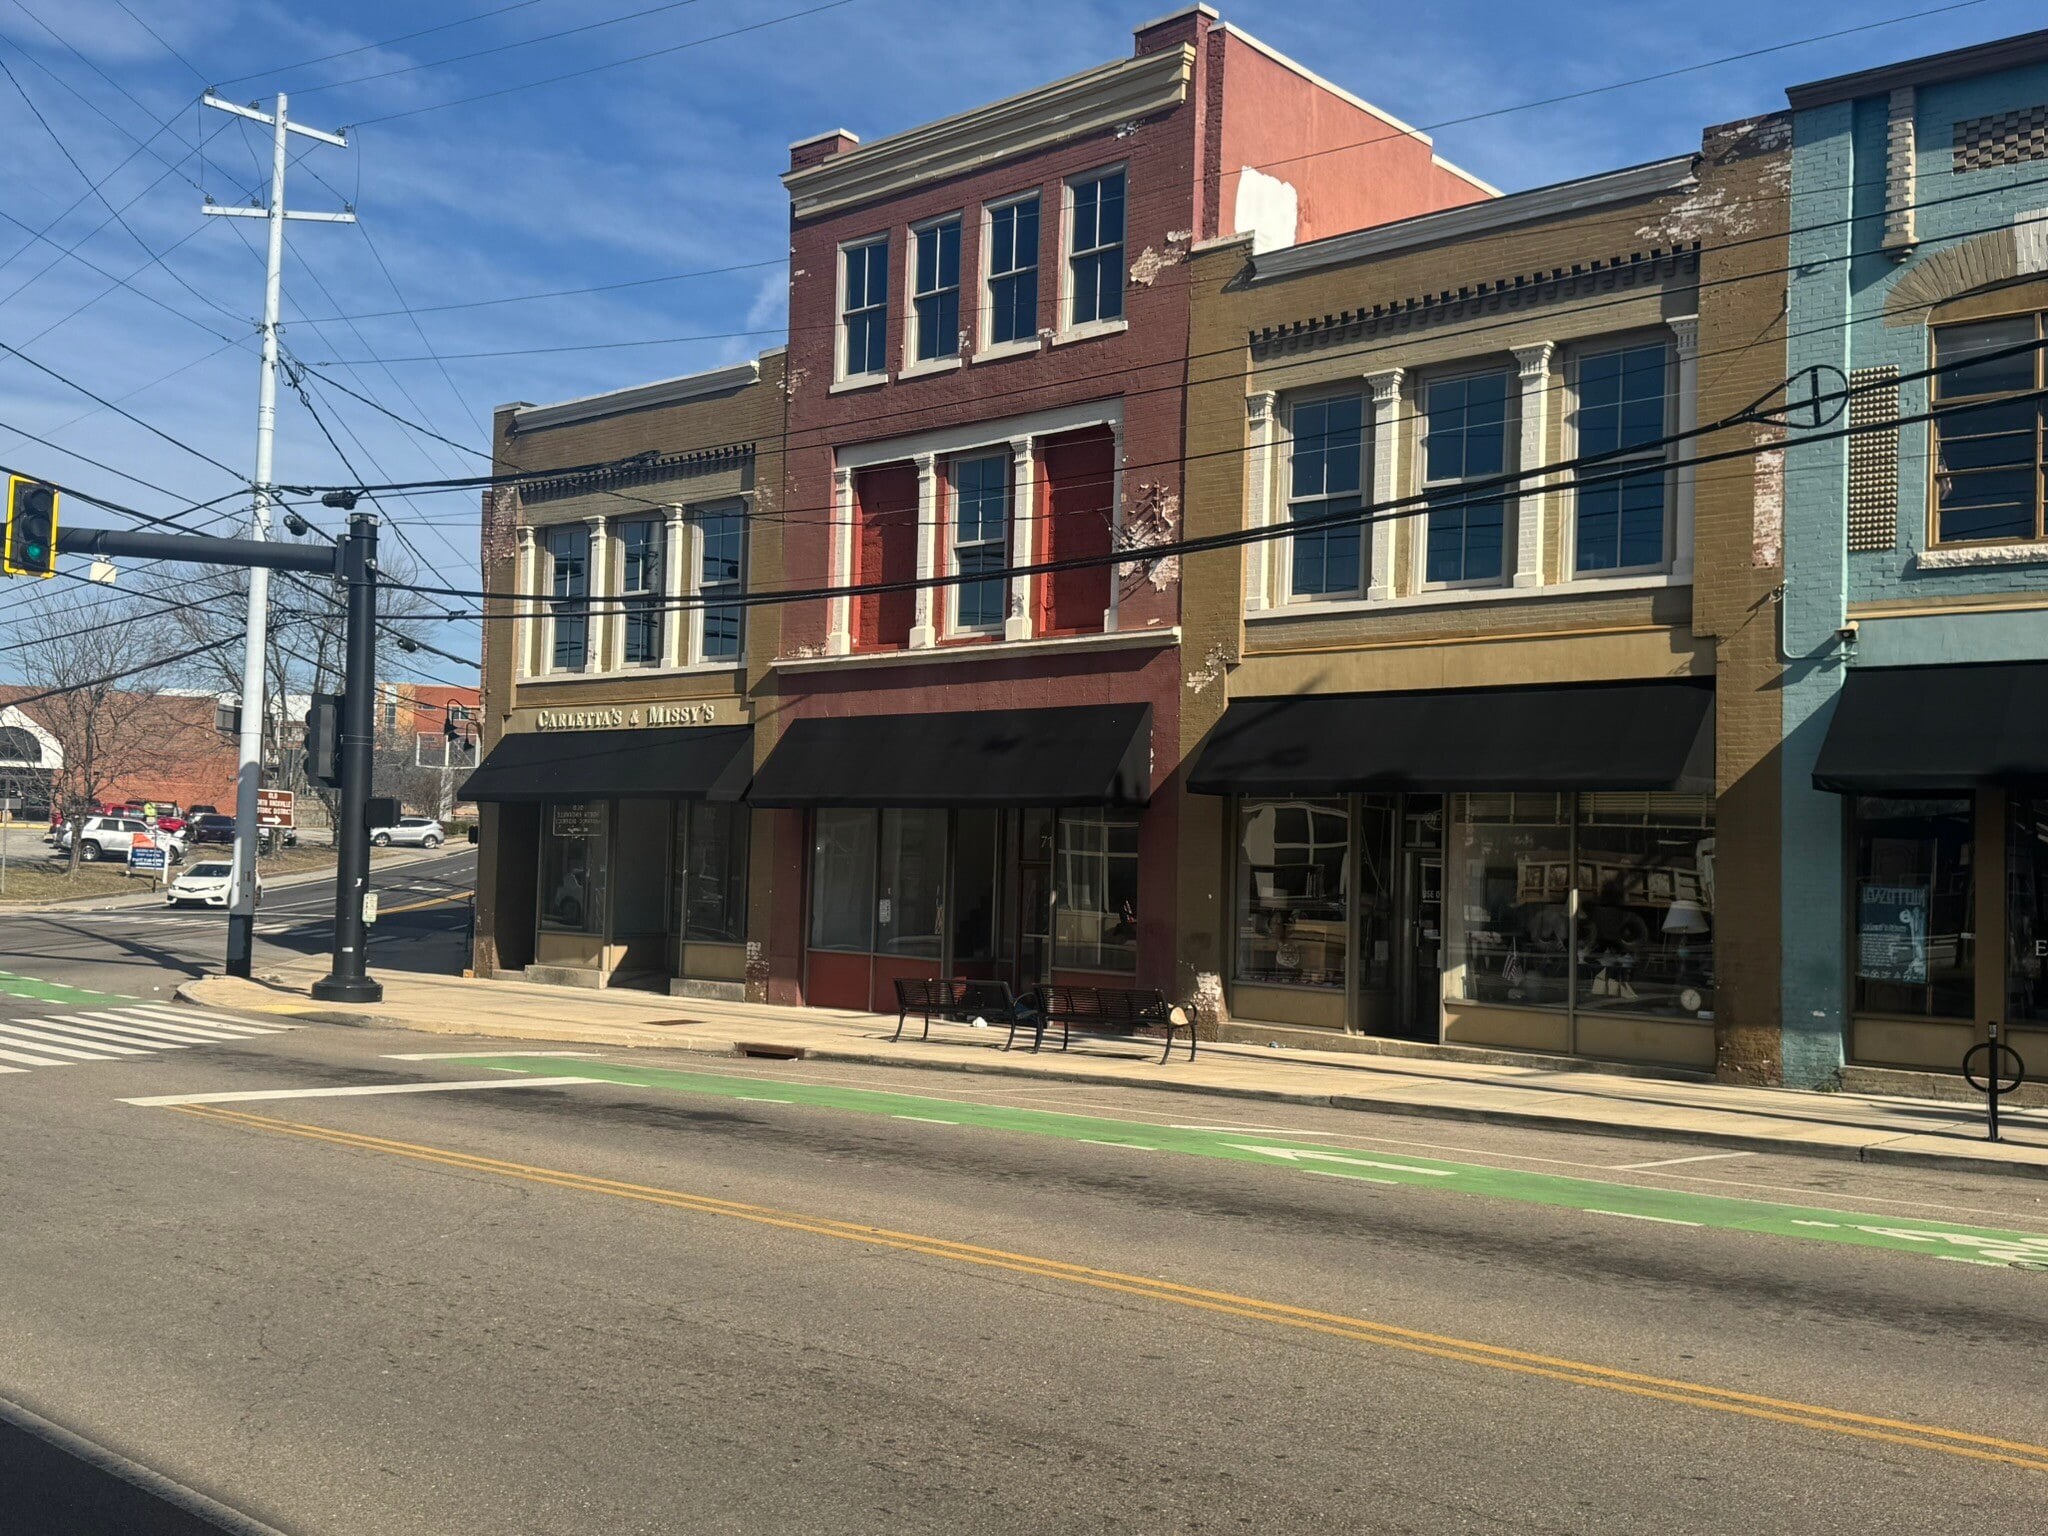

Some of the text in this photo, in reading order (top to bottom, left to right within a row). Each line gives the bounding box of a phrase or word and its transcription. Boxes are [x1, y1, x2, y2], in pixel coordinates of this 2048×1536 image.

[537, 703, 715, 728] CARLETTA'S & MISSY'S
[257, 806, 272, 814] STORIC
[1041, 836, 1052, 848] 71
